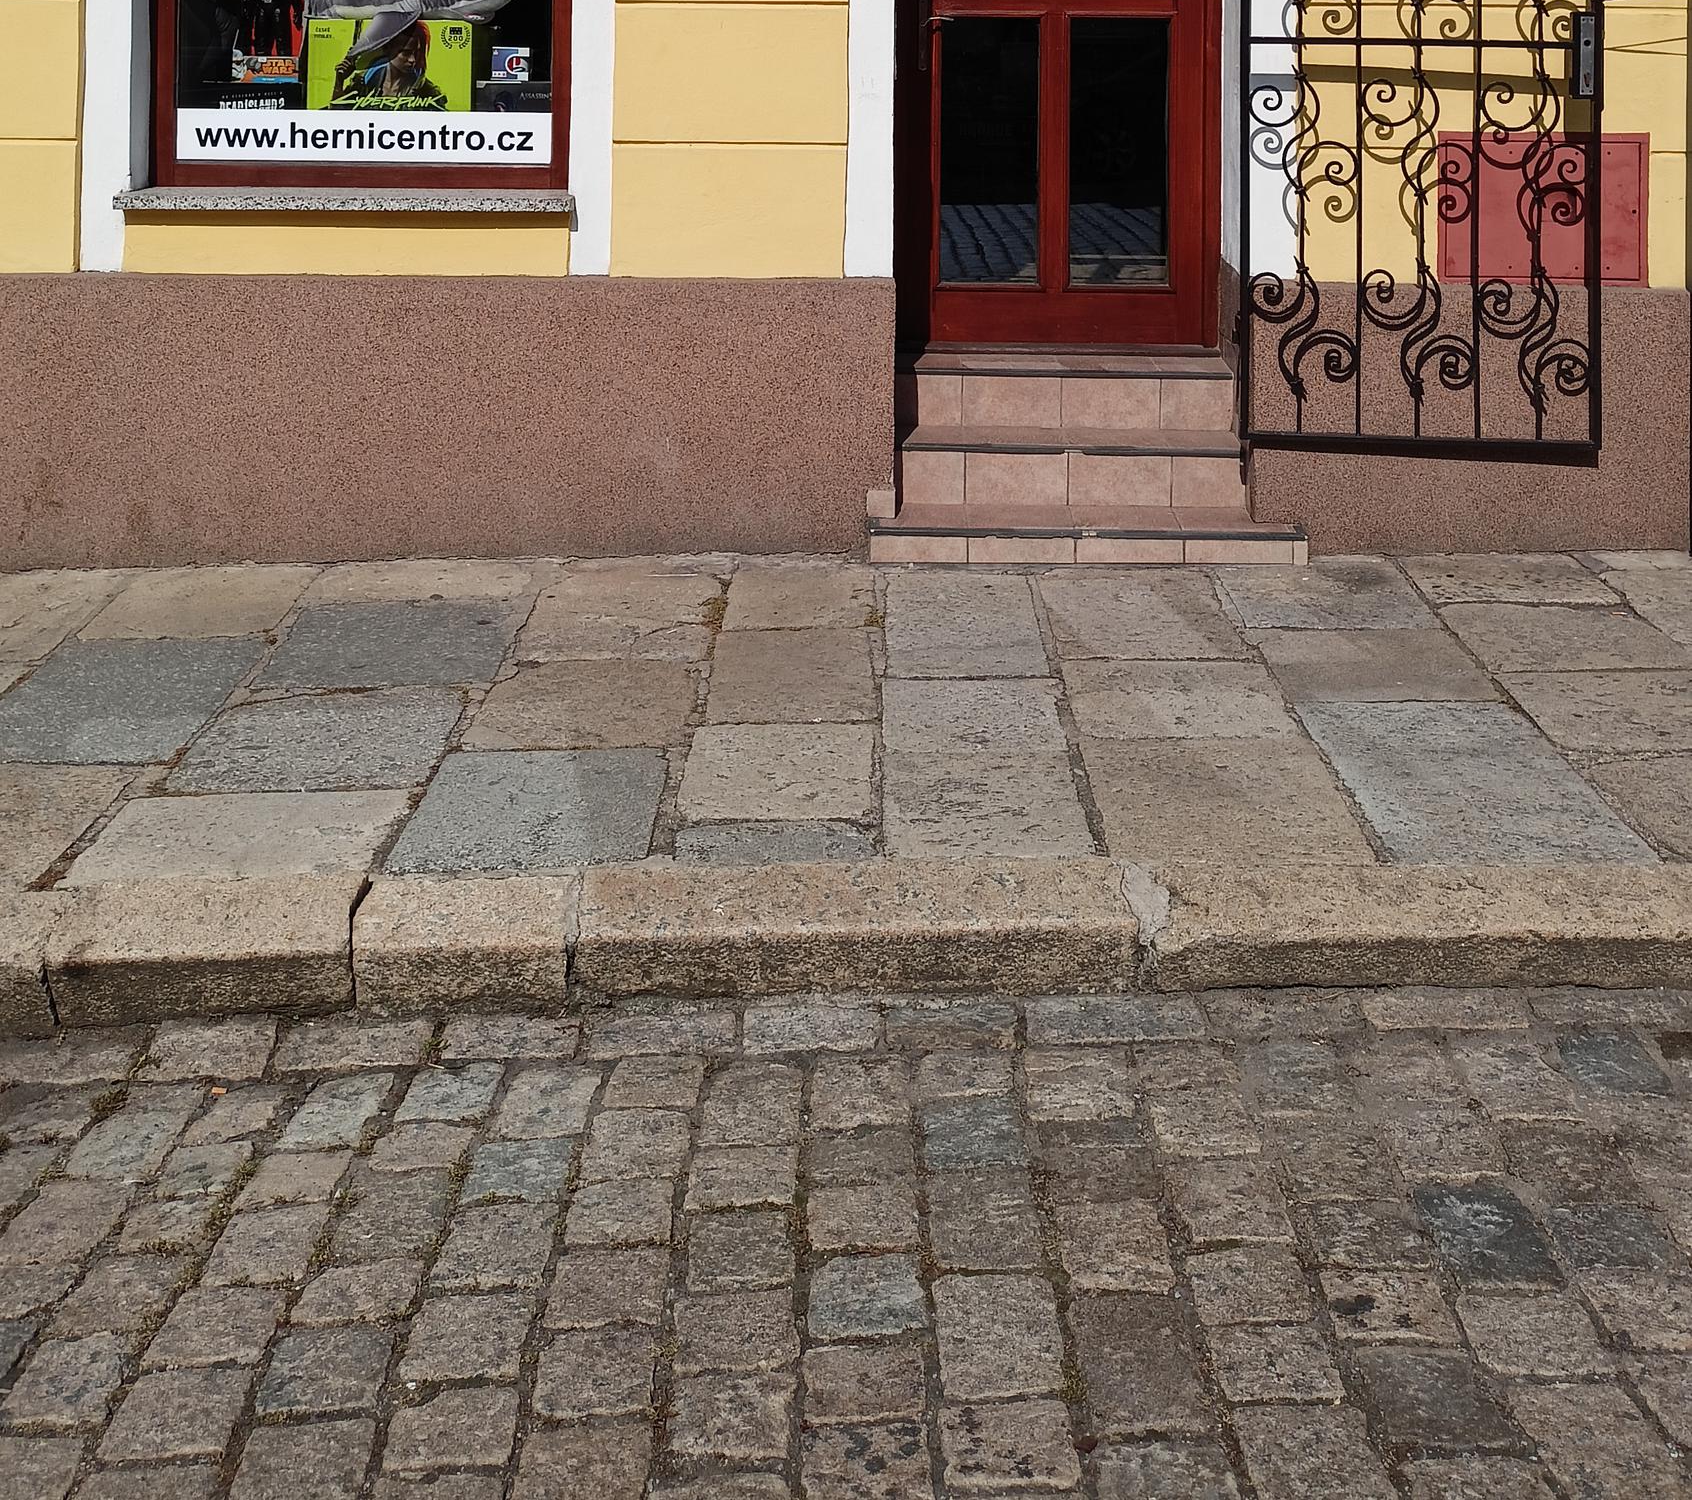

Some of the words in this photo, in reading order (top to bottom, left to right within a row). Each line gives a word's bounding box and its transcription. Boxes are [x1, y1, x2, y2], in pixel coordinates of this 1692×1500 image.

[262, 59, 296, 67] STAR
[262, 66, 296, 75] WARS
[195, 121, 534, 152] www.hernicentro.cz
